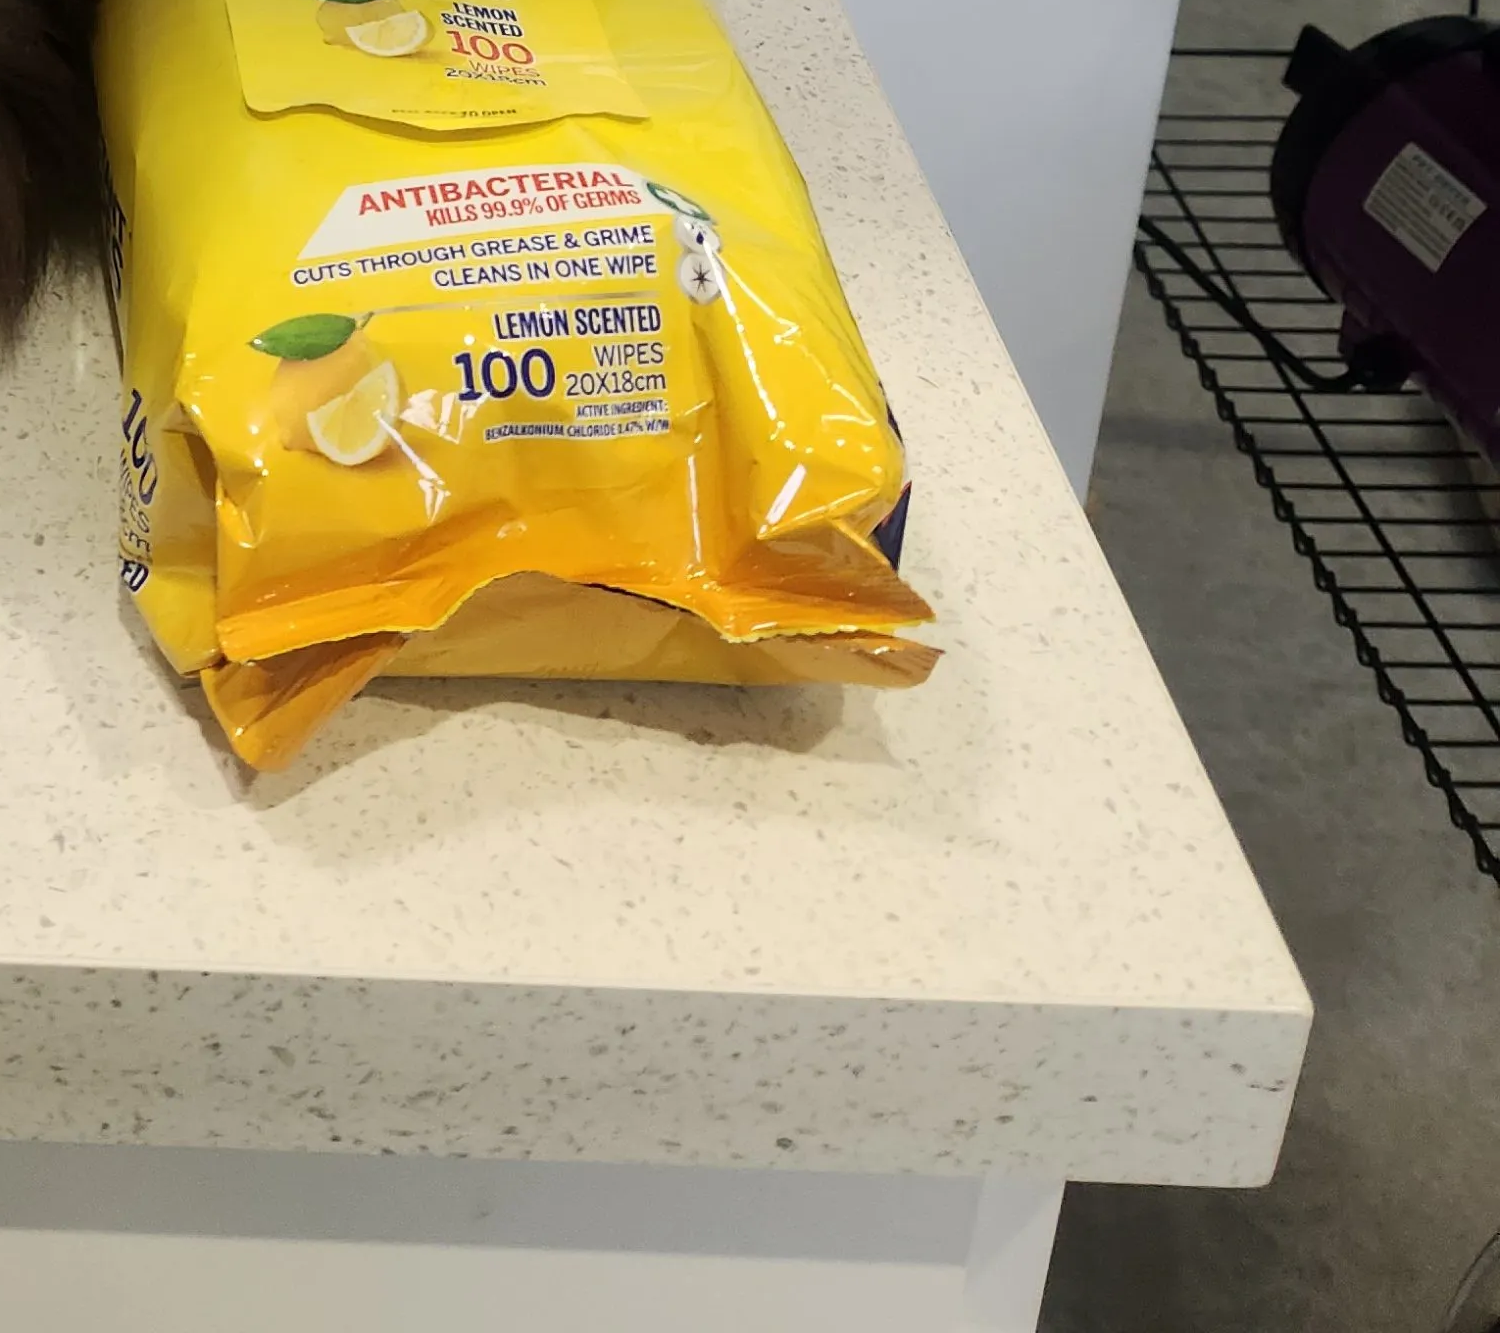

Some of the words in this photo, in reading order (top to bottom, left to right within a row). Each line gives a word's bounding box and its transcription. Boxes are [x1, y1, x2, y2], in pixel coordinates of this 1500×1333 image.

[441, 12, 523, 37] SCENTED
[452, 1, 518, 22] LEMON
[446, 29, 534, 65] 100
[469, 60, 541, 78] WIPES
[359, 169, 634, 216] ANTIBACTERIAL
[426, 203, 479, 227] KILLS
[481, 196, 544, 219] 99.9%
[546, 193, 569, 213] OF
[572, 189, 643, 211] GERMS
[293, 262, 353, 286] CUTS
[356, 242, 467, 277] THROUGH
[470, 233, 558, 259] GREASE
[563, 232, 581, 249] &
[583, 224, 655, 248] GRIME
[434, 263, 522, 288] CLEANS
[528, 262, 550, 281] IN
[555, 257, 603, 278] ONE
[604, 253, 658, 276] WIPE
[493, 308, 570, 341] LEMON
[574, 304, 662, 336] SCENTED
[593, 341, 665, 368] WIPES
[455, 347, 557, 402] 100
[566, 369, 667, 398] 20X18cm
[576, 403, 609, 419] ACTIVE
[121, 388, 158, 506] 100
[485, 423, 565, 442] BENZALKONIUM
[566, 420, 617, 439] CHLORIDE
